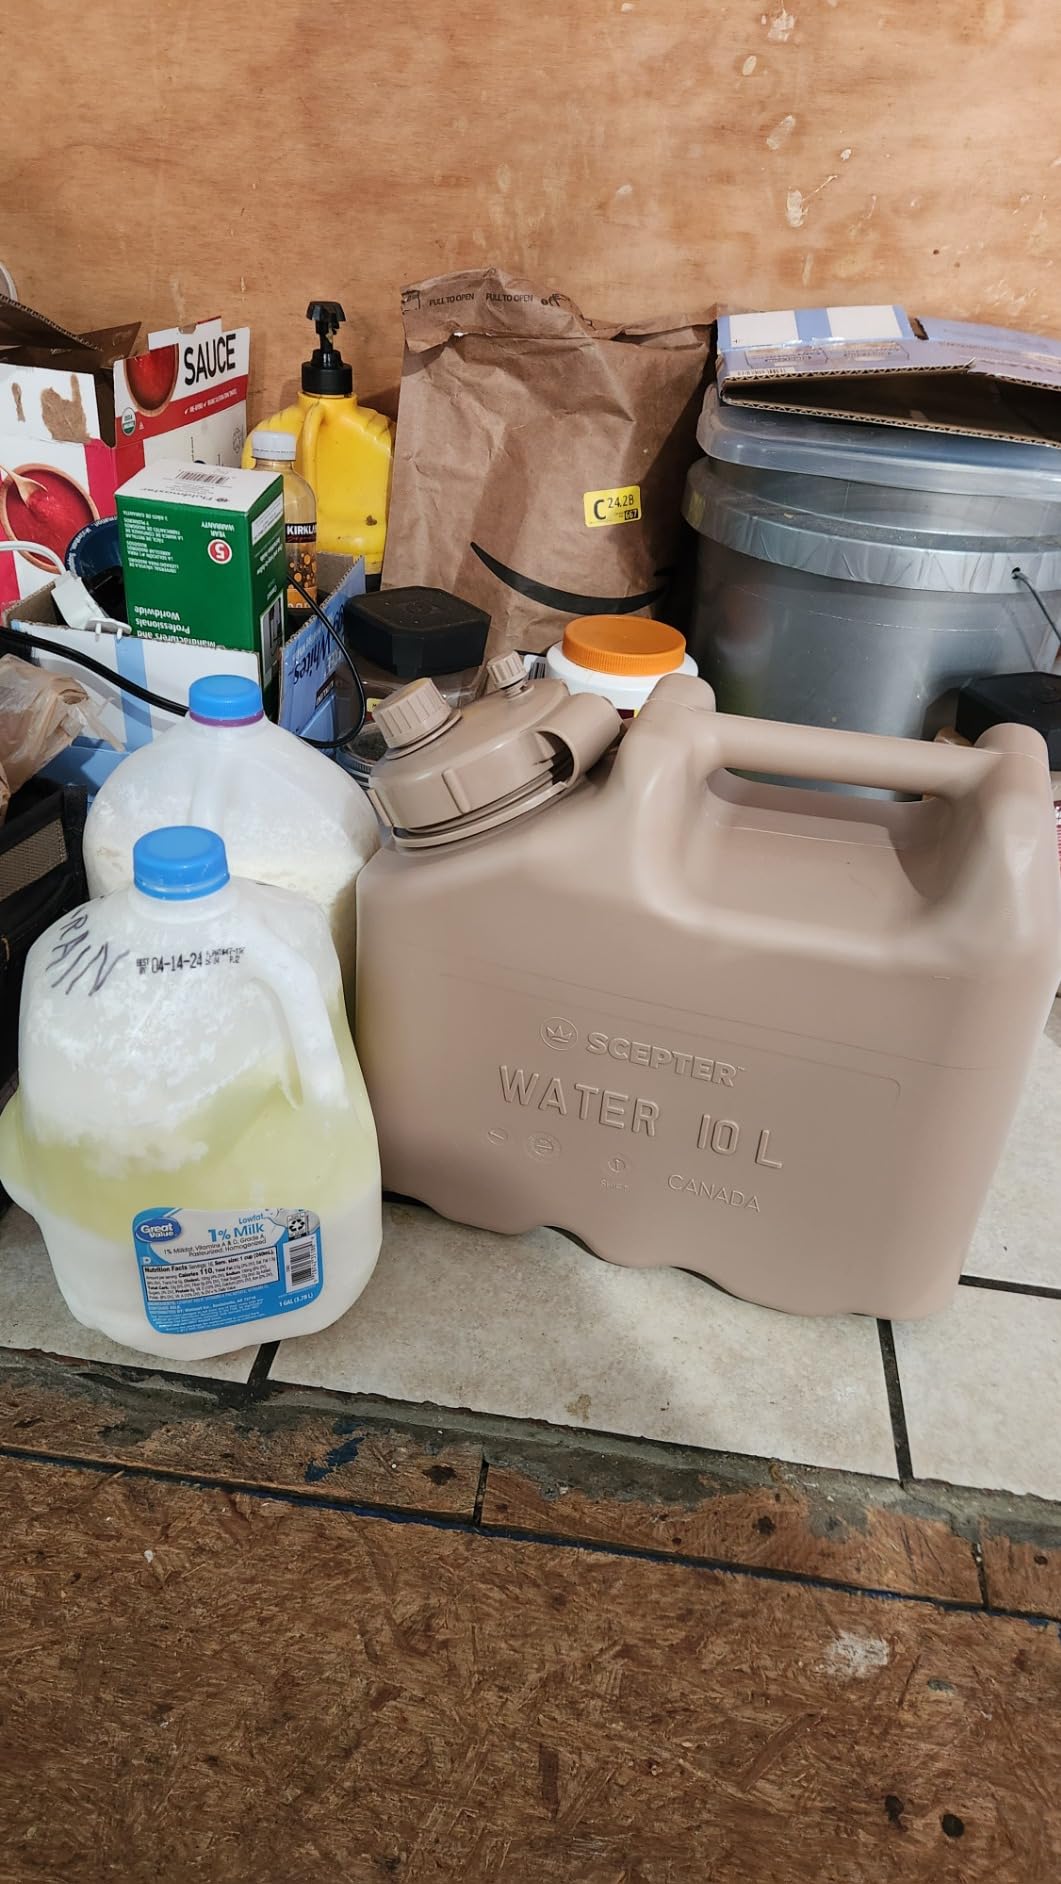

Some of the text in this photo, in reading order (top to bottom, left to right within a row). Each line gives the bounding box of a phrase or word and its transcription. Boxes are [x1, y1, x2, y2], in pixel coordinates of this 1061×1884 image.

[445, 296, 455, 304] TO
[456, 293, 474, 302] OPEN
[503, 294, 513, 302] TO
[513, 294, 533, 302] OPEN
[184, 333, 236, 386] SAUCE
[593, 498, 606, 520] C
[201, 521, 235, 531] WARRANTY
[210, 530, 226, 538] YEAR
[214, 543, 225, 559] 5
[134, 605, 181, 621] Worldwide
[135, 617, 190, 634] Professionals
[46, 906, 130, 997] RAIN
[151, 951, 203, 974] 04-14-24
[585, 1031, 737, 1087] SCEPTER
[499, 1064, 783, 1169] WATER 10 L
[667, 1174, 761, 1213] CANADA
[238, 1213, 264, 1225] Lowfat
[140, 1222, 173, 1234] Great
[149, 1231, 174, 1239] Value
[208, 1223, 265, 1243] 1% Milk
